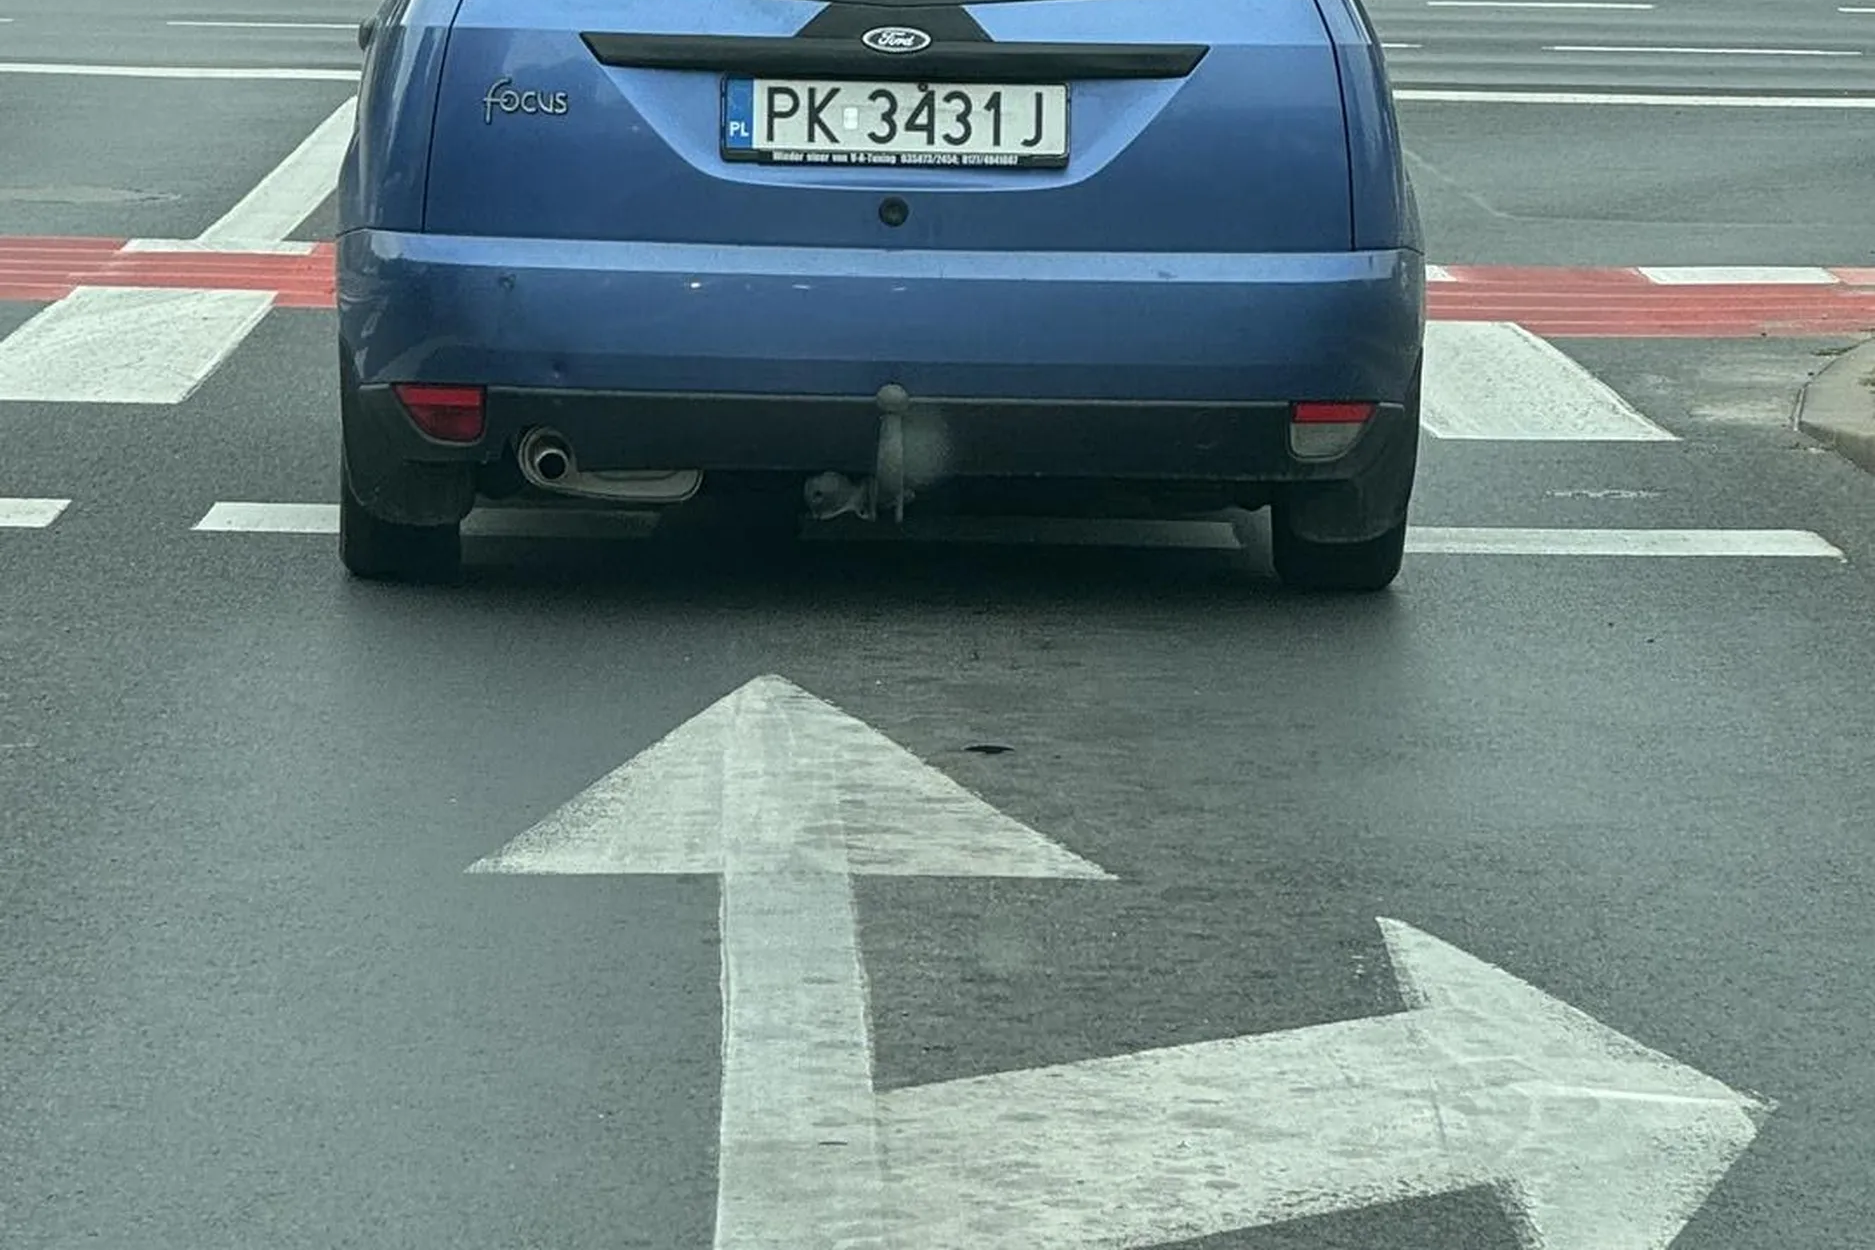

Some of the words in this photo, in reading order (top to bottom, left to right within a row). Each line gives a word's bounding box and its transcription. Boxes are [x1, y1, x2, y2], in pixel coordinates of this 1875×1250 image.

[878, 31, 915, 46] Ford
[766, 86, 840, 143] PK
[729, 121, 750, 137] PL
